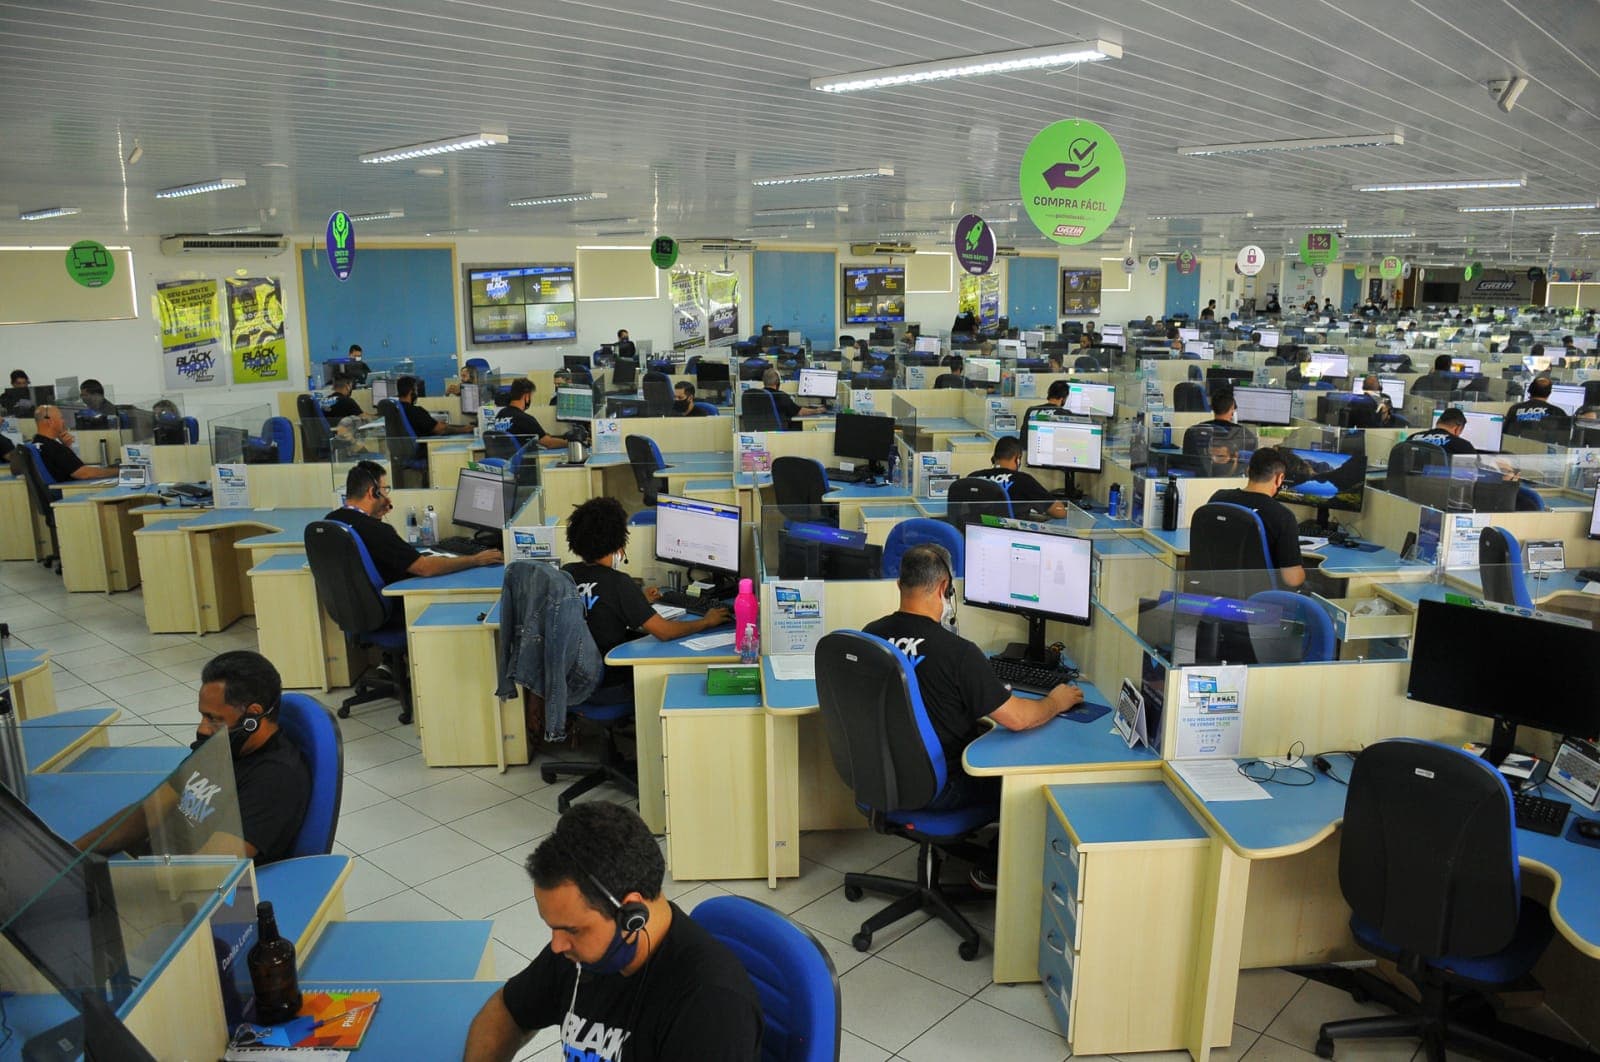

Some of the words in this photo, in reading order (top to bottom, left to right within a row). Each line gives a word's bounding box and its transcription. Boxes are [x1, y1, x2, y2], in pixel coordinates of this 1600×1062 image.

[1033, 195, 1078, 209] COMPRA
[1080, 198, 1107, 212] FÁCIL
[176, 350, 212, 367] BLACK
[243, 347, 275, 362] BLACK
[561, 1011, 631, 1062] BLACK
